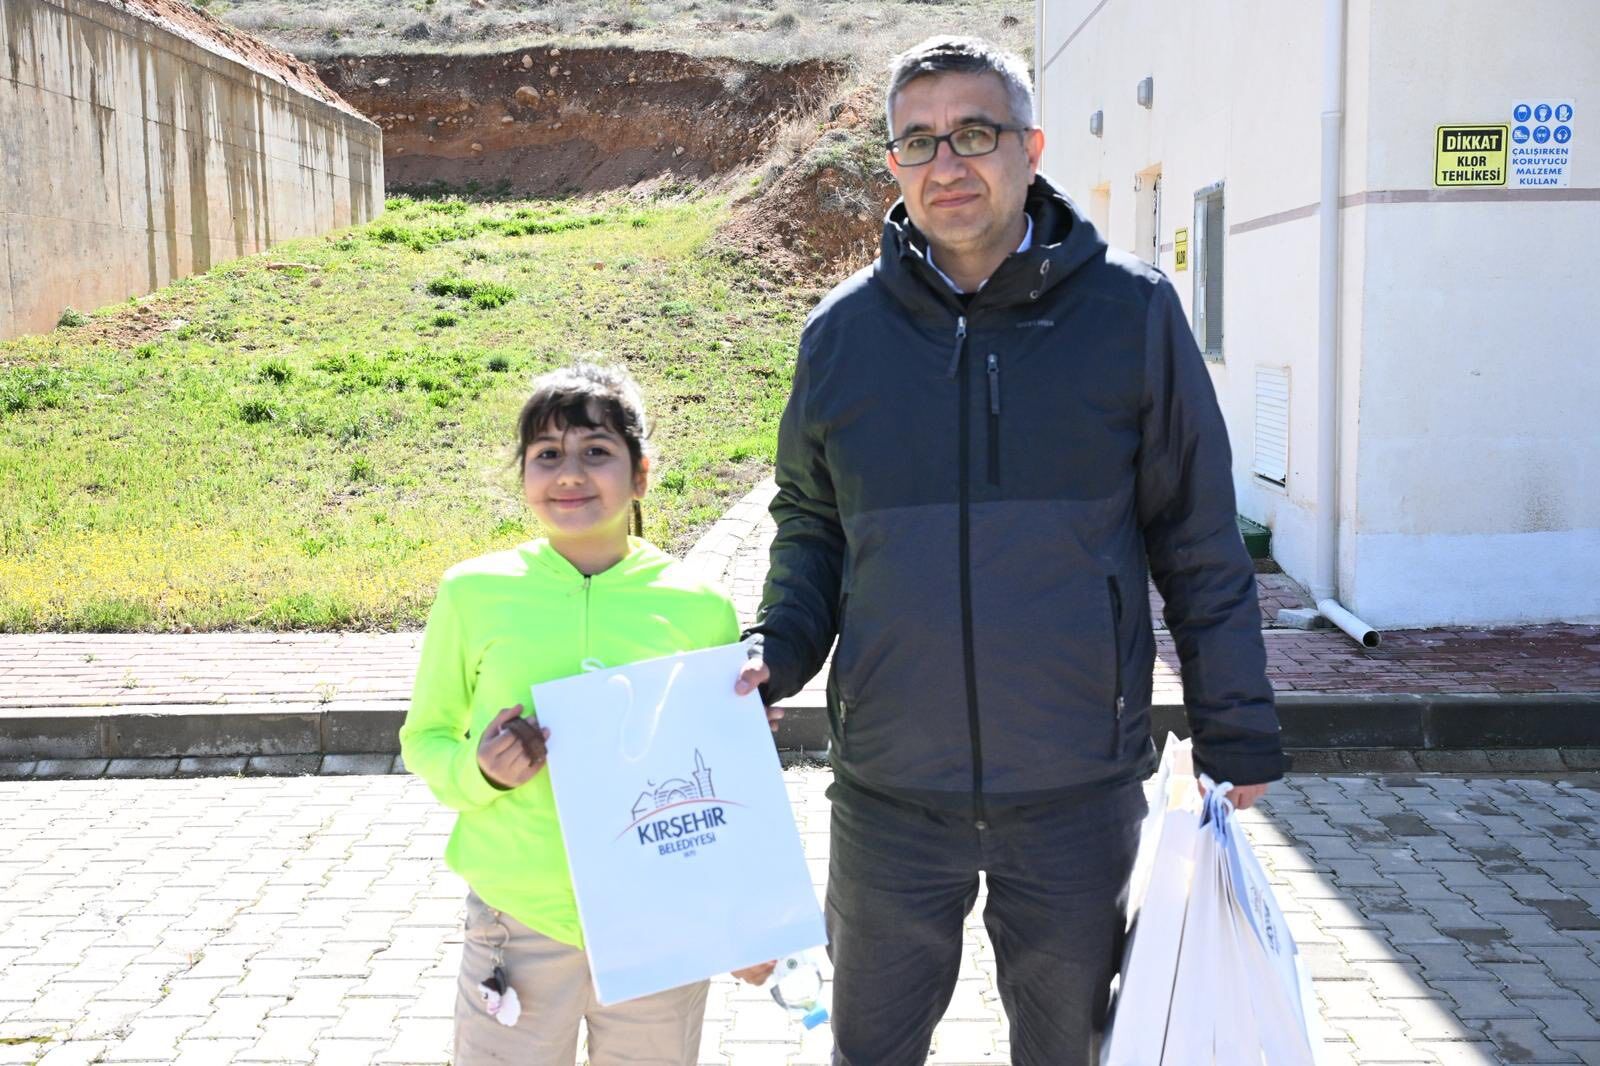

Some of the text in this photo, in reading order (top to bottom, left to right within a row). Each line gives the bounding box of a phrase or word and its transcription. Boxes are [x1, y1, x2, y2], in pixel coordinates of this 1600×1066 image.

[1446, 132, 1499, 150] DİKKAT
[1512, 148, 1569, 156] ÇALIŞIRKEN
[1457, 156, 1487, 167] KLOR
[1441, 167, 1501, 182] TEHLİKESİ
